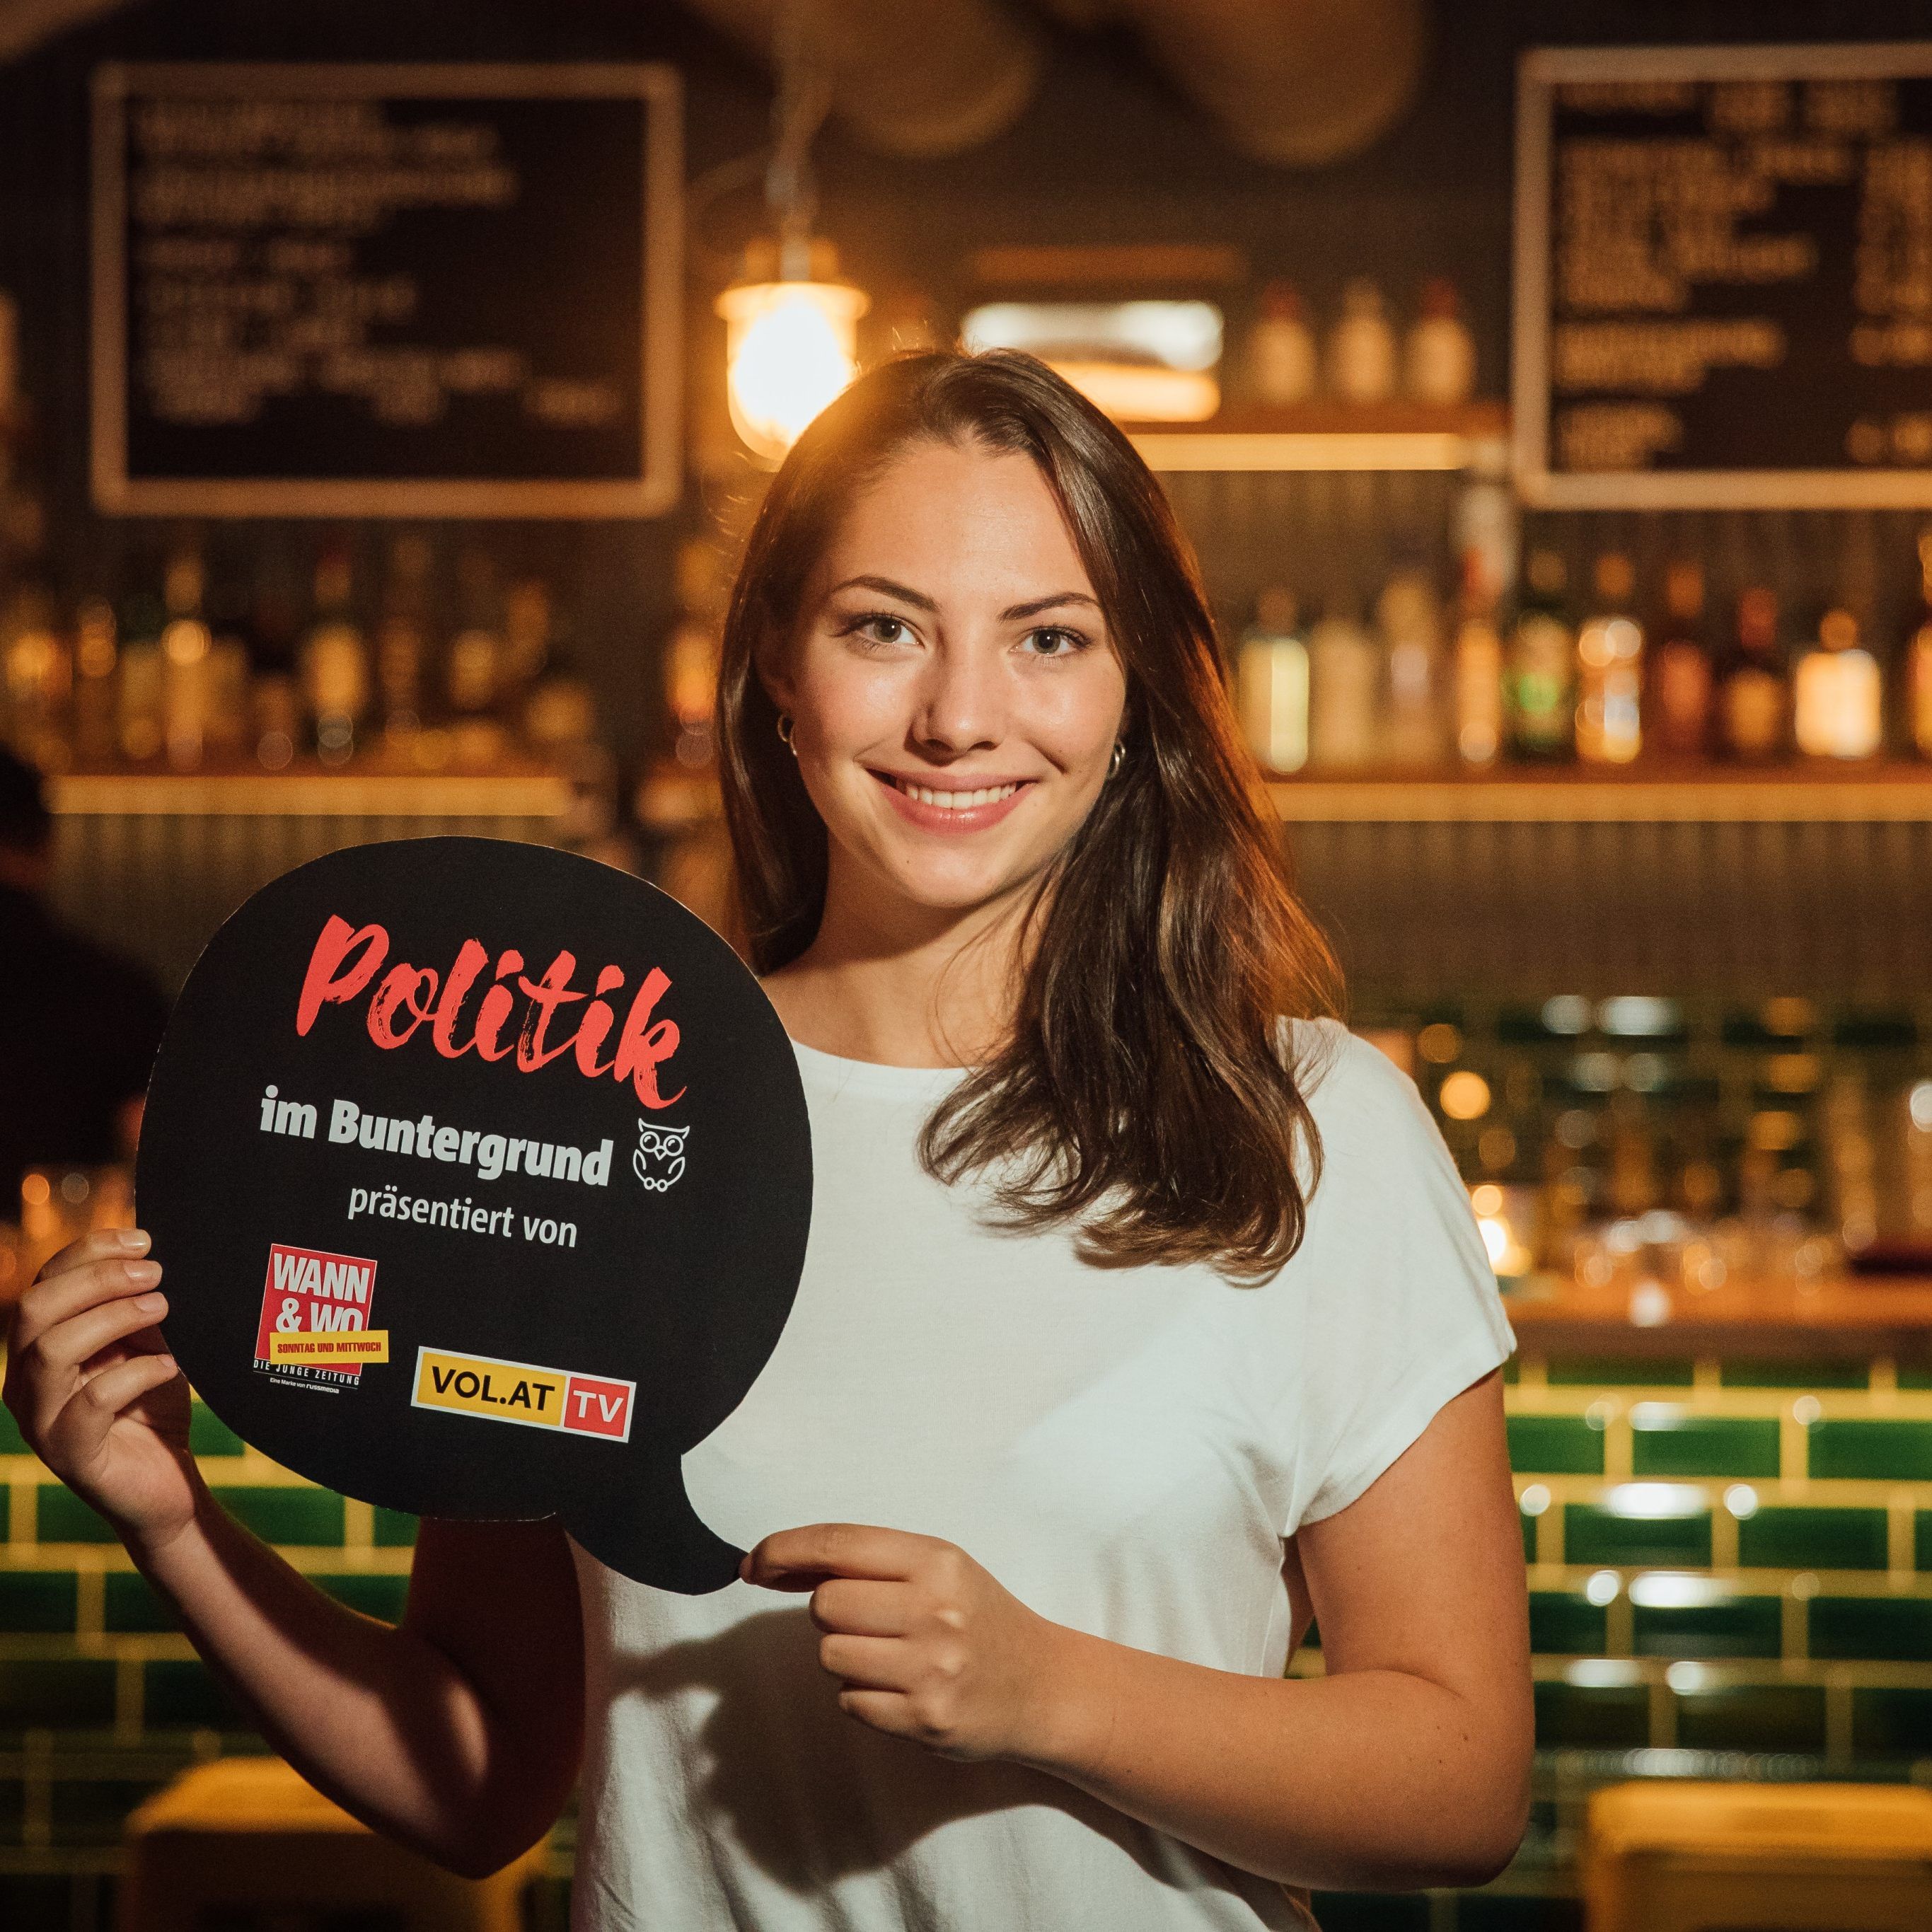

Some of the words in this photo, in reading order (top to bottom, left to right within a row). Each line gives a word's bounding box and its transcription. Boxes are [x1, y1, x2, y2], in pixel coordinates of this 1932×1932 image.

[296, 914, 688, 1110] Politik
[260, 1084, 317, 1140] im
[328, 1099, 613, 1186] Buntergrund
[347, 1184, 514, 1237] präsentiert
[523, 1217, 577, 1248] von
[274, 1252, 371, 1304] WANN
[275, 1297, 302, 1334] &
[311, 1302, 364, 1333] WO
[253, 1359, 271, 1371] DIE
[276, 1363, 309, 1377] JUNGE
[315, 1370, 360, 1386] ZEITUNG
[277, 1343, 316, 1354] SONNTAG
[317, 1342, 335, 1353] UND
[337, 1341, 381, 1353] MITTWOCH
[431, 1366, 556, 1411] VOL.AT
[573, 1389, 624, 1424] TV
